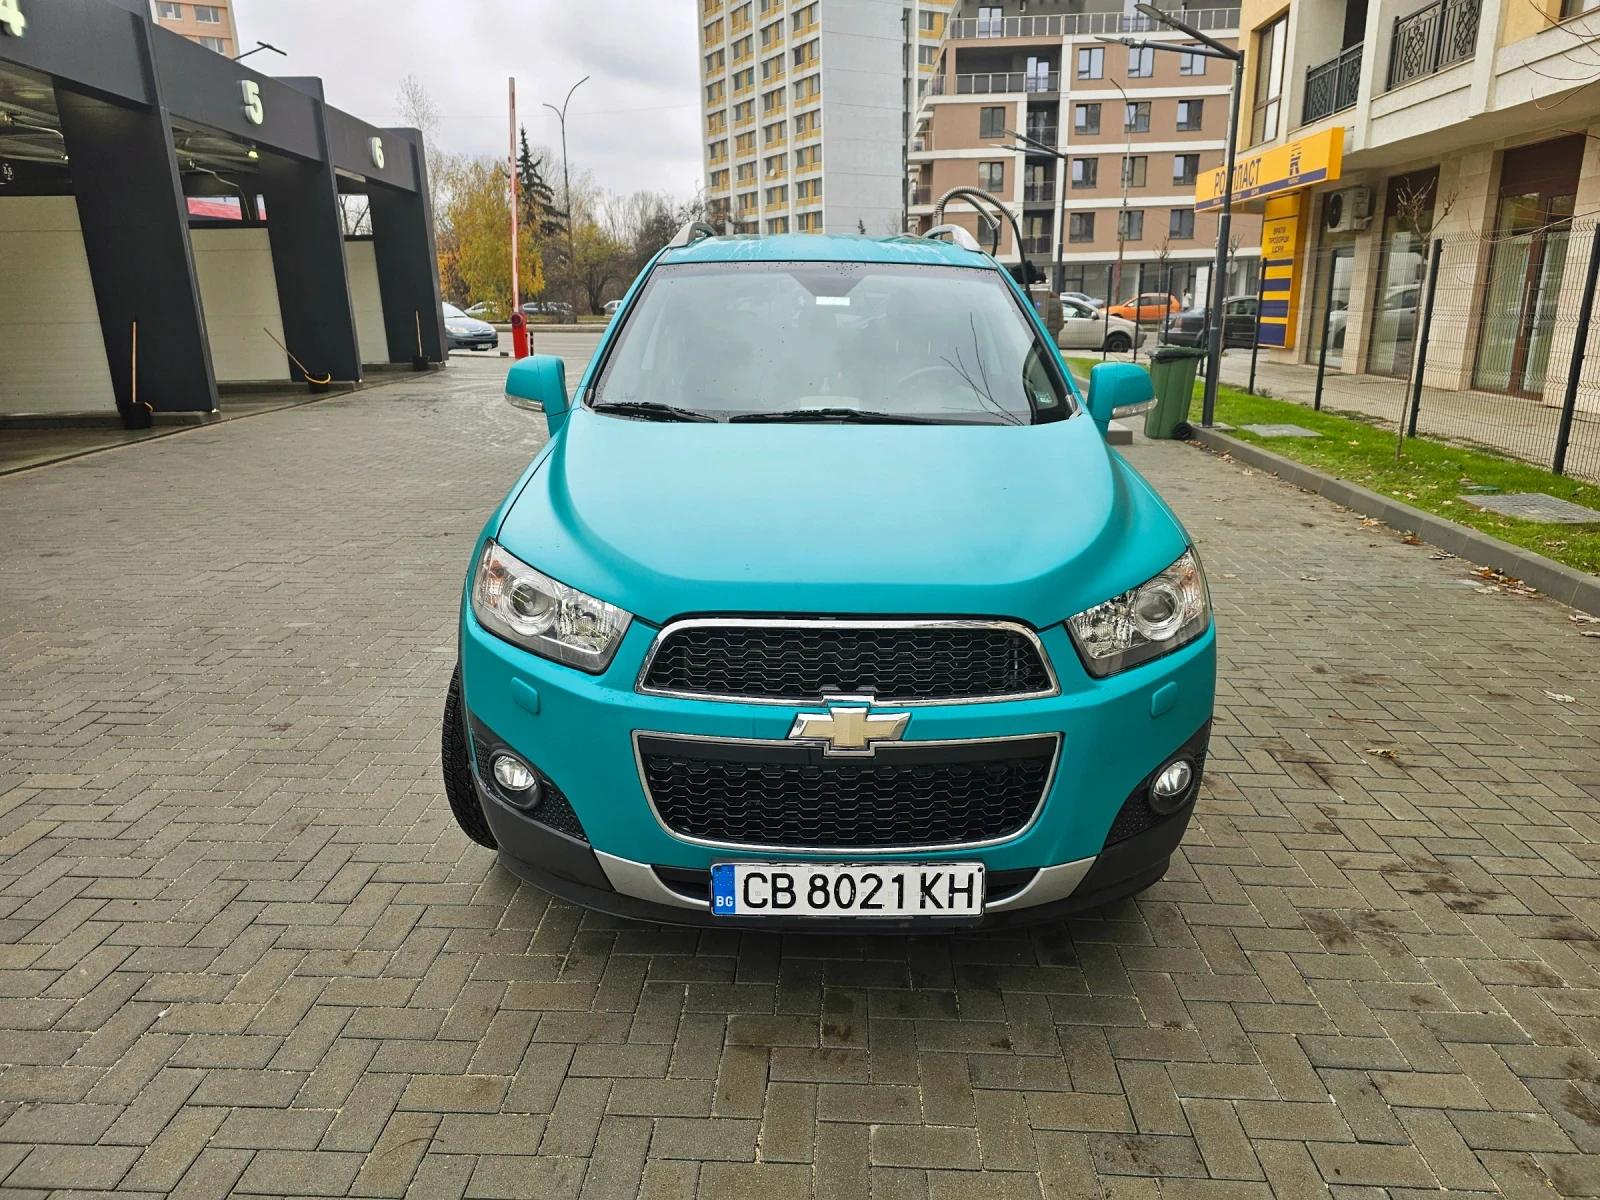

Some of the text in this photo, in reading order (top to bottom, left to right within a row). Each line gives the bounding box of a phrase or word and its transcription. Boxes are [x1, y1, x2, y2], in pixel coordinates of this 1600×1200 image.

[240, 80, 264, 125] 5
[371, 136, 385, 169] 6
[716, 895, 734, 907] BG
[743, 872, 974, 909] CB 8021 KH
